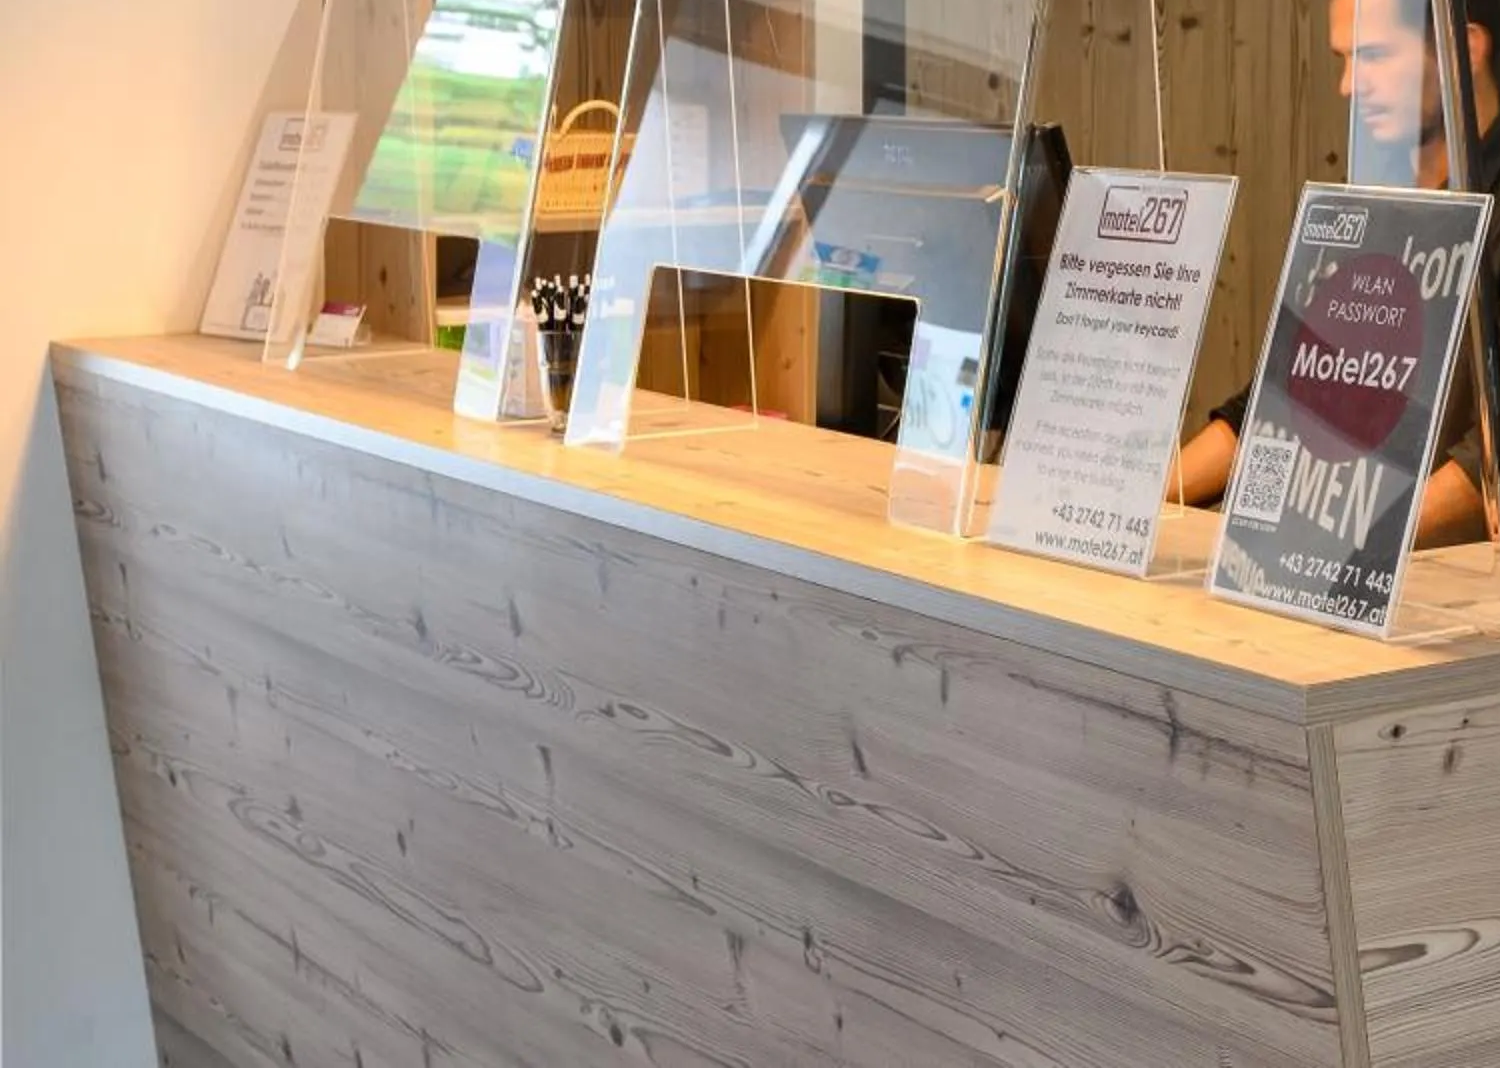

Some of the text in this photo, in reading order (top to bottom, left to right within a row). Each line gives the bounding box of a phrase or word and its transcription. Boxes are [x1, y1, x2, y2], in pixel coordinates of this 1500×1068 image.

[1060, 253, 1201, 283] Bitte vergessen Sie Ihre
[1352, 273, 1395, 296] WLAN
[1065, 282, 1184, 311] Zimmerkarte nicht!
[1327, 299, 1408, 328] PASSWORT
[1291, 342, 1419, 392] Motel267
[1052, 501, 1152, 538] +43 2742 71 443
[1034, 531, 1144, 566] www.motel267.at
[1279, 551, 1393, 594] +43 2742 71 443
[1261, 581, 1388, 624] www.motel267.at
